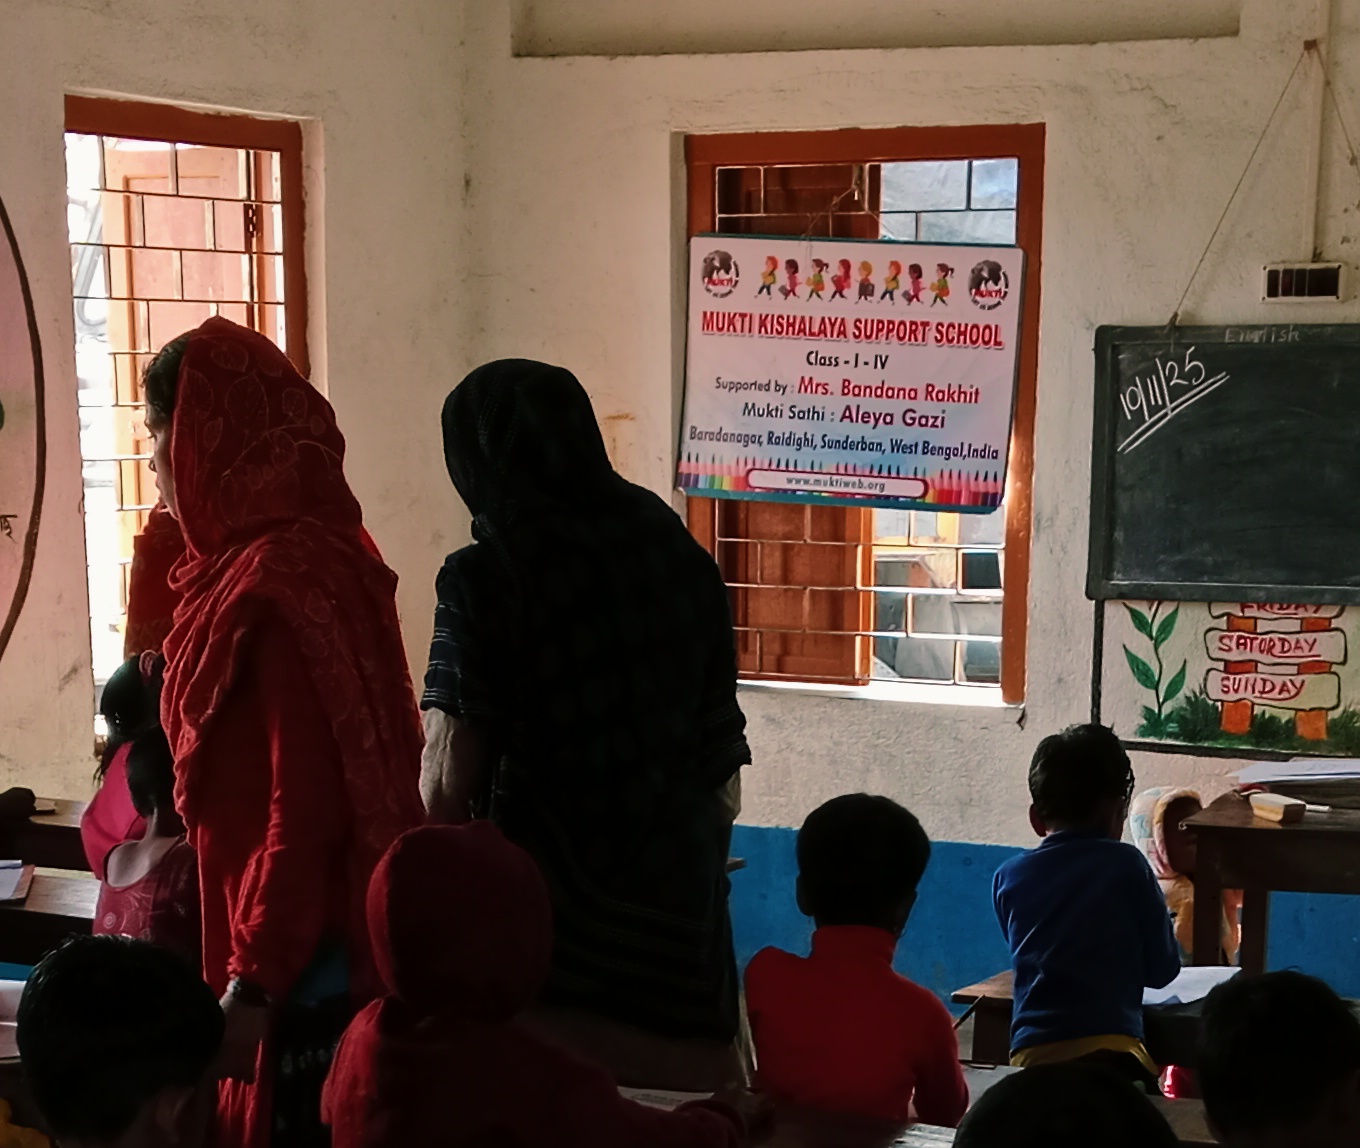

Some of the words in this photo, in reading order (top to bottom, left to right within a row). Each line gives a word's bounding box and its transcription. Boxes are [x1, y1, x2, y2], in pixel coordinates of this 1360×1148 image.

[702, 311, 753, 334] MUKTI
[758, 314, 847, 339] KISHALAYA
[852, 318, 930, 343] SUPPORT
[934, 322, 1003, 347] SCHOOL
[806, 351, 839, 368] Class
[874, 354, 889, 369] IV
[715, 377, 771, 393] Supported
[798, 376, 834, 396] Mrs.
[841, 379, 918, 401] Bandana
[925, 383, 980, 404] Rakhit
[1120, 345, 1205, 421] 10/11/25
[742, 402, 783, 419] Mukti
[789, 405, 825, 421] Sathi
[840, 404, 894, 429] Aleya
[902, 408, 946, 428] Gazi
[690, 425, 764, 448] Baradanagar,
[820, 434, 886, 455] Sunderban,
[890, 438, 918, 454] West
[786, 476, 886, 493] www.muktiweb.org
[1220, 675, 1305, 701] SUNDAY
